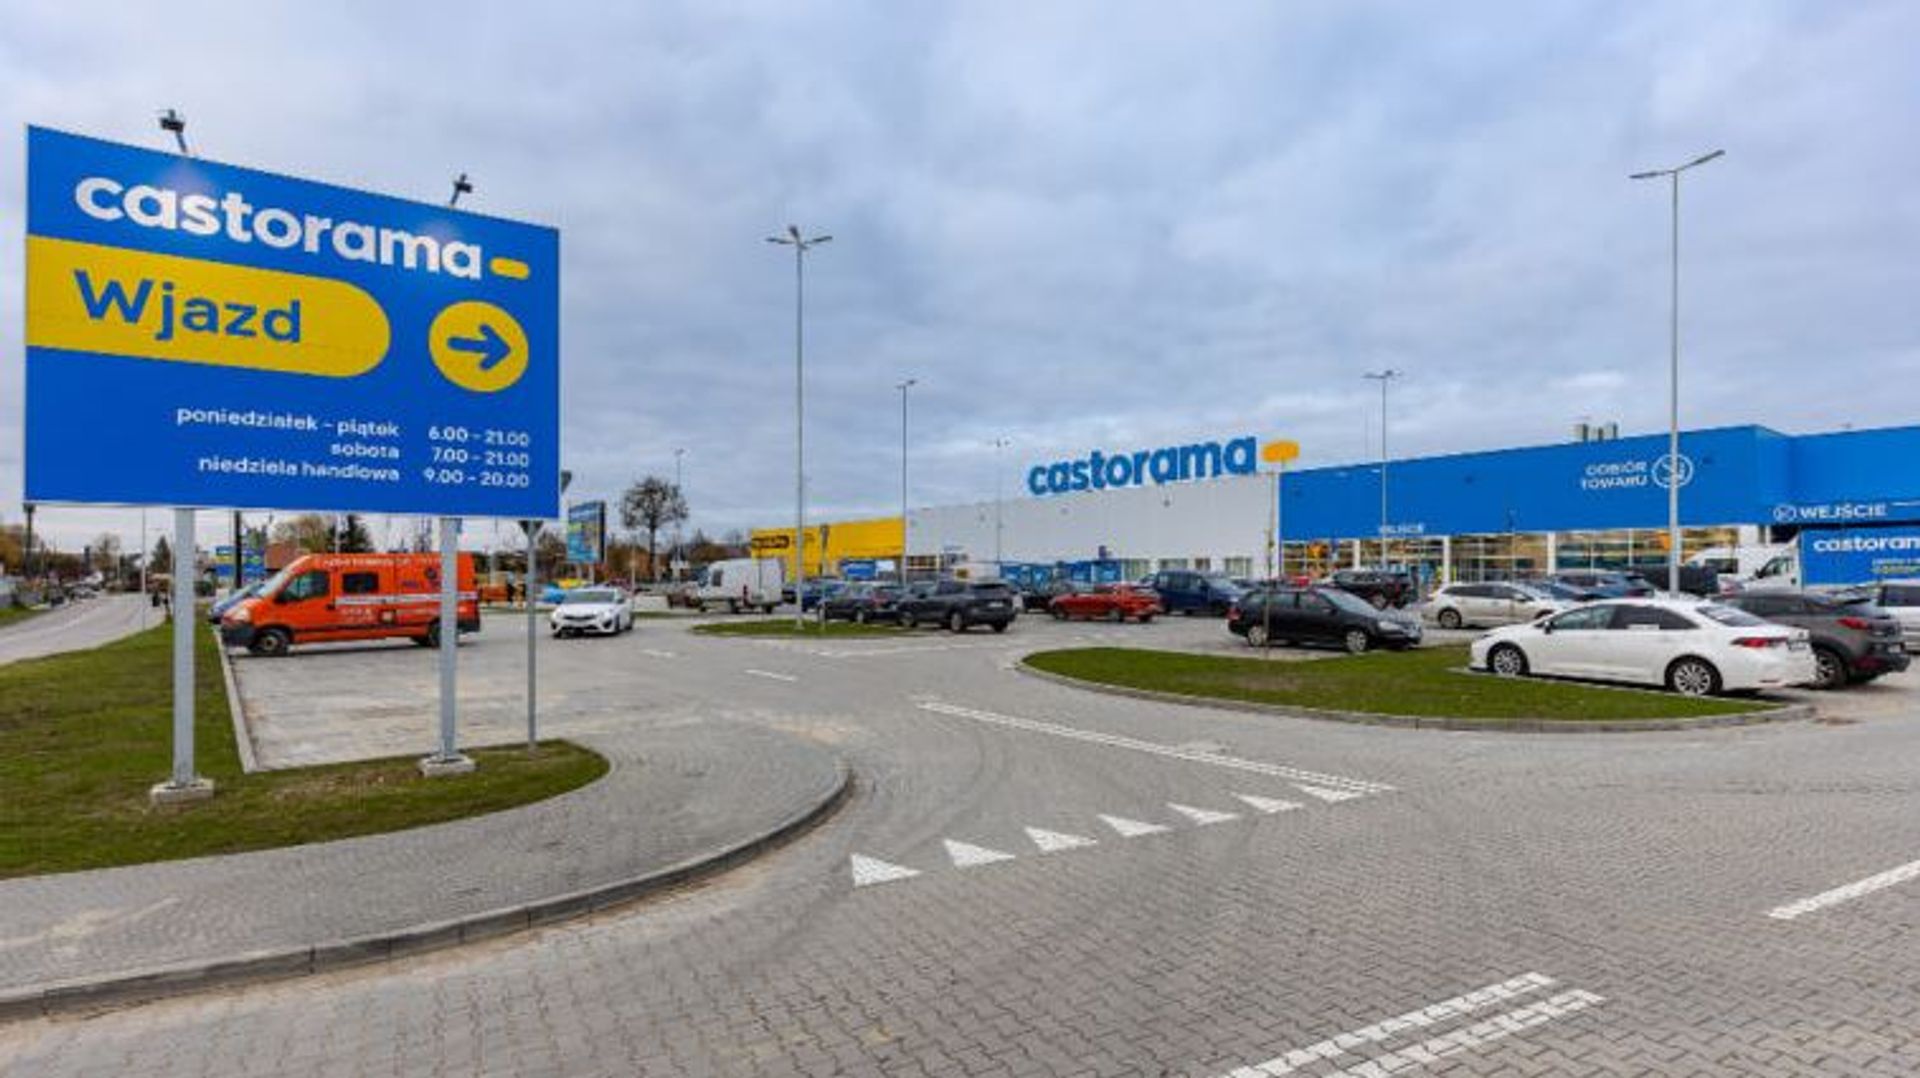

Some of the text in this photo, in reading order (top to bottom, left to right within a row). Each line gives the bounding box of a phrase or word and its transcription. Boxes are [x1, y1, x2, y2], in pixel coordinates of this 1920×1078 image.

[74, 176, 482, 281] castorama
[73, 269, 301, 343] Wjazd
[176, 407, 318, 431] poniedziałek
[337, 419, 400, 438] piątek
[428, 425, 469, 443] 6.00
[484, 429, 530, 448] 21.00
[330, 441, 400, 460] sobota
[484, 450, 530, 468] 21.00
[198, 454, 400, 482] niedziela handlowa
[423, 466, 464, 484] 9.00
[480, 471, 530, 488] 20.00
[1027, 435, 1257, 496] castorama
[1799, 502, 1887, 519] WEJŚCIE
